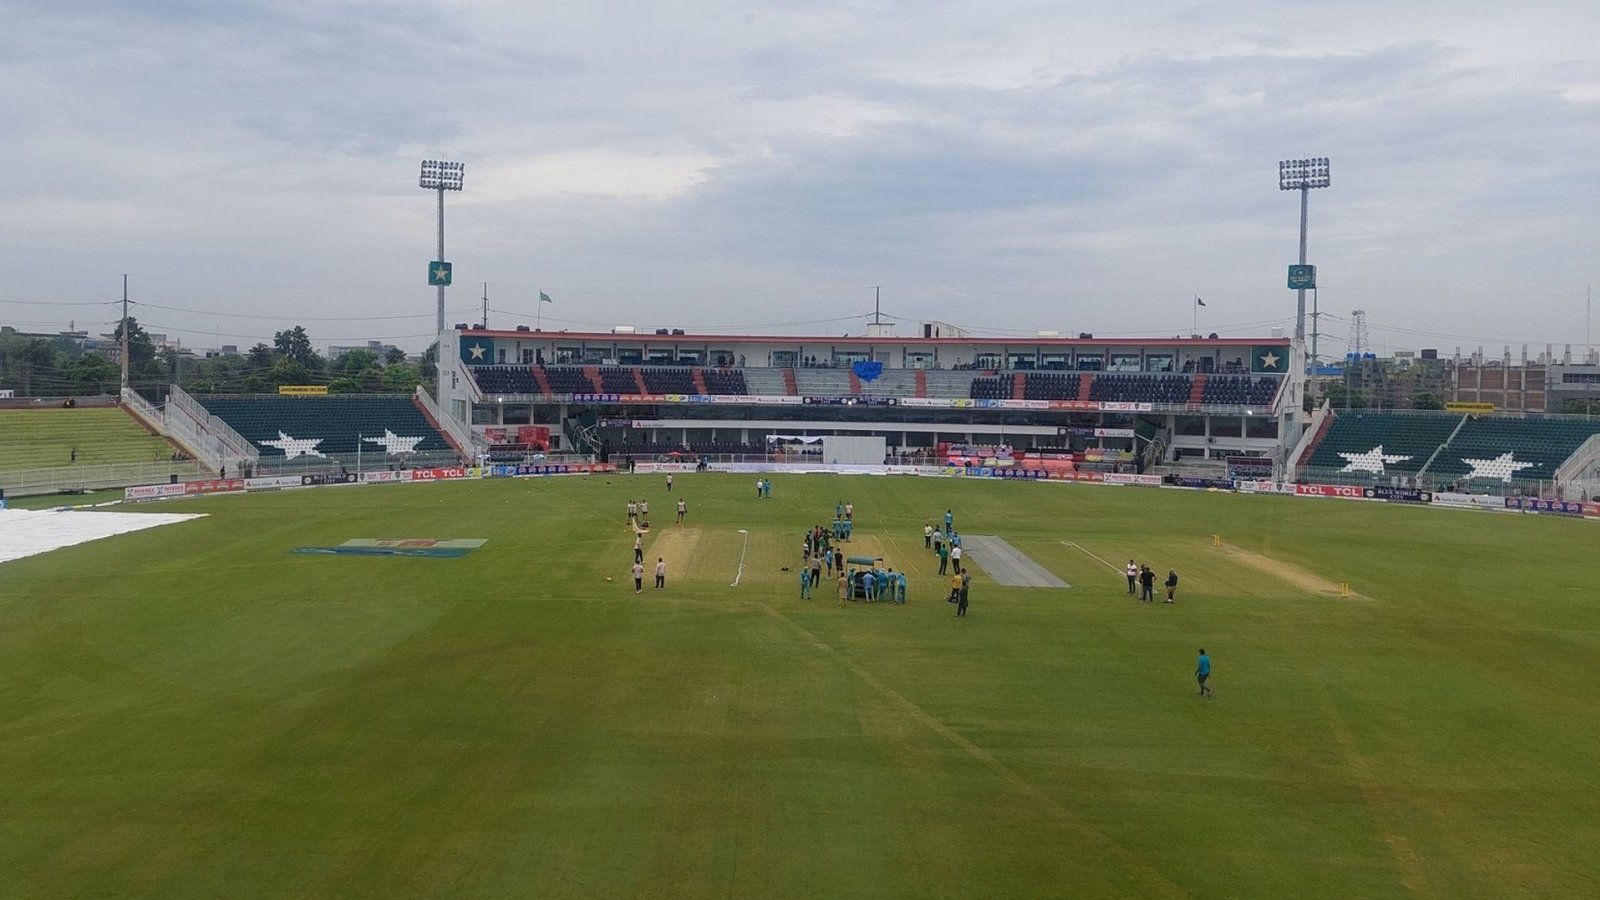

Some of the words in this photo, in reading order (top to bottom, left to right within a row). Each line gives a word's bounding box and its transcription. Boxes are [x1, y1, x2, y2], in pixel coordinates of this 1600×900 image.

[442, 469, 463, 477] TCL
[1300, 485, 1326, 494] TCL
[1333, 487, 1360, 496] TCL
